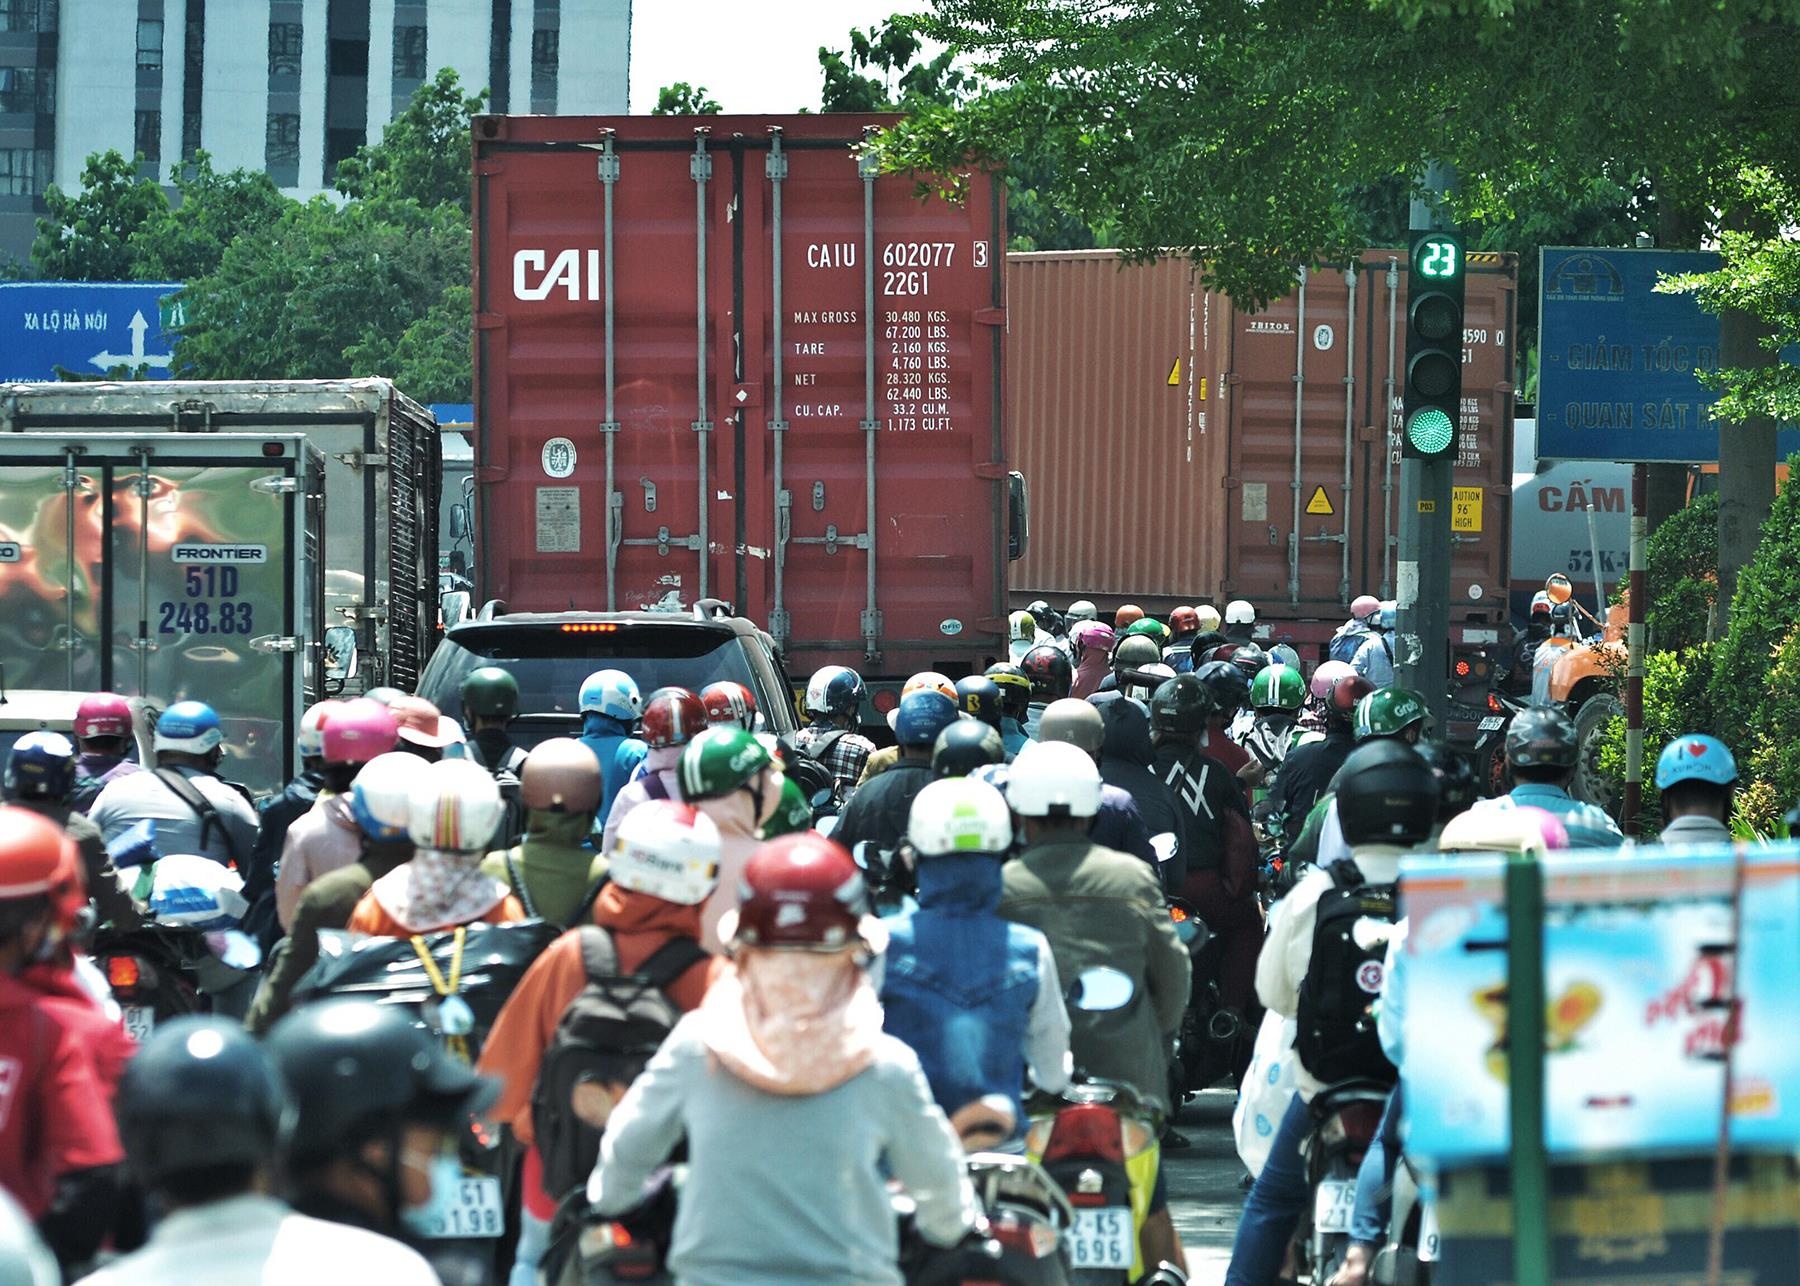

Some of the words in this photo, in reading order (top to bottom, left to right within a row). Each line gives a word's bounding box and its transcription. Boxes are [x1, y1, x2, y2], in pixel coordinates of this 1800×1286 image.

[807, 243, 856, 268] CAIU
[883, 243, 955, 267] 602077
[974, 242, 988, 266] 3
[1422, 242, 1456, 276] 23
[513, 249, 600, 301] CAI
[883, 271, 928, 296] 22G1
[24, 312, 39, 330] XA
[63, 308, 81, 330] HÀ
[84, 309, 108, 333] NỘI
[794, 312, 818, 324] MAX
[821, 311, 857, 324] GROSS
[885, 311, 921, 323] 30.480
[927, 310, 950, 323] KGS.
[885, 326, 921, 338] 67.200
[927, 326, 950, 338] LBS.
[795, 343, 825, 355] TARE
[892, 342, 921, 354] 2.160
[927, 342, 950, 353] KGS.
[892, 357, 921, 369] 4.760
[928, 356, 950, 369] LBS.
[795, 374, 816, 386] NET
[886, 373, 921, 385] 28.320
[928, 373, 951, 384] KGS.
[886, 388, 922, 400] 62.440
[928, 387, 951, 400] LBS.
[795, 405, 814, 417] CU.
[817, 404, 843, 417] CAP.
[893, 403, 916, 415] 33.2
[921, 403, 950, 415] CU.M.
[1565, 401, 1633, 431] QUAN
[1642, 397, 1689, 430] SÁT
[888, 418, 916, 431] 1.173
[922, 418, 953, 431] CU.FT.
[1538, 479, 1626, 513] CẤM
[1454, 518, 1472, 528] HIGH
[176, 548, 262, 559] FRONTIER
[185, 566, 238, 598] 51D
[158, 602, 253, 634] 248.83
